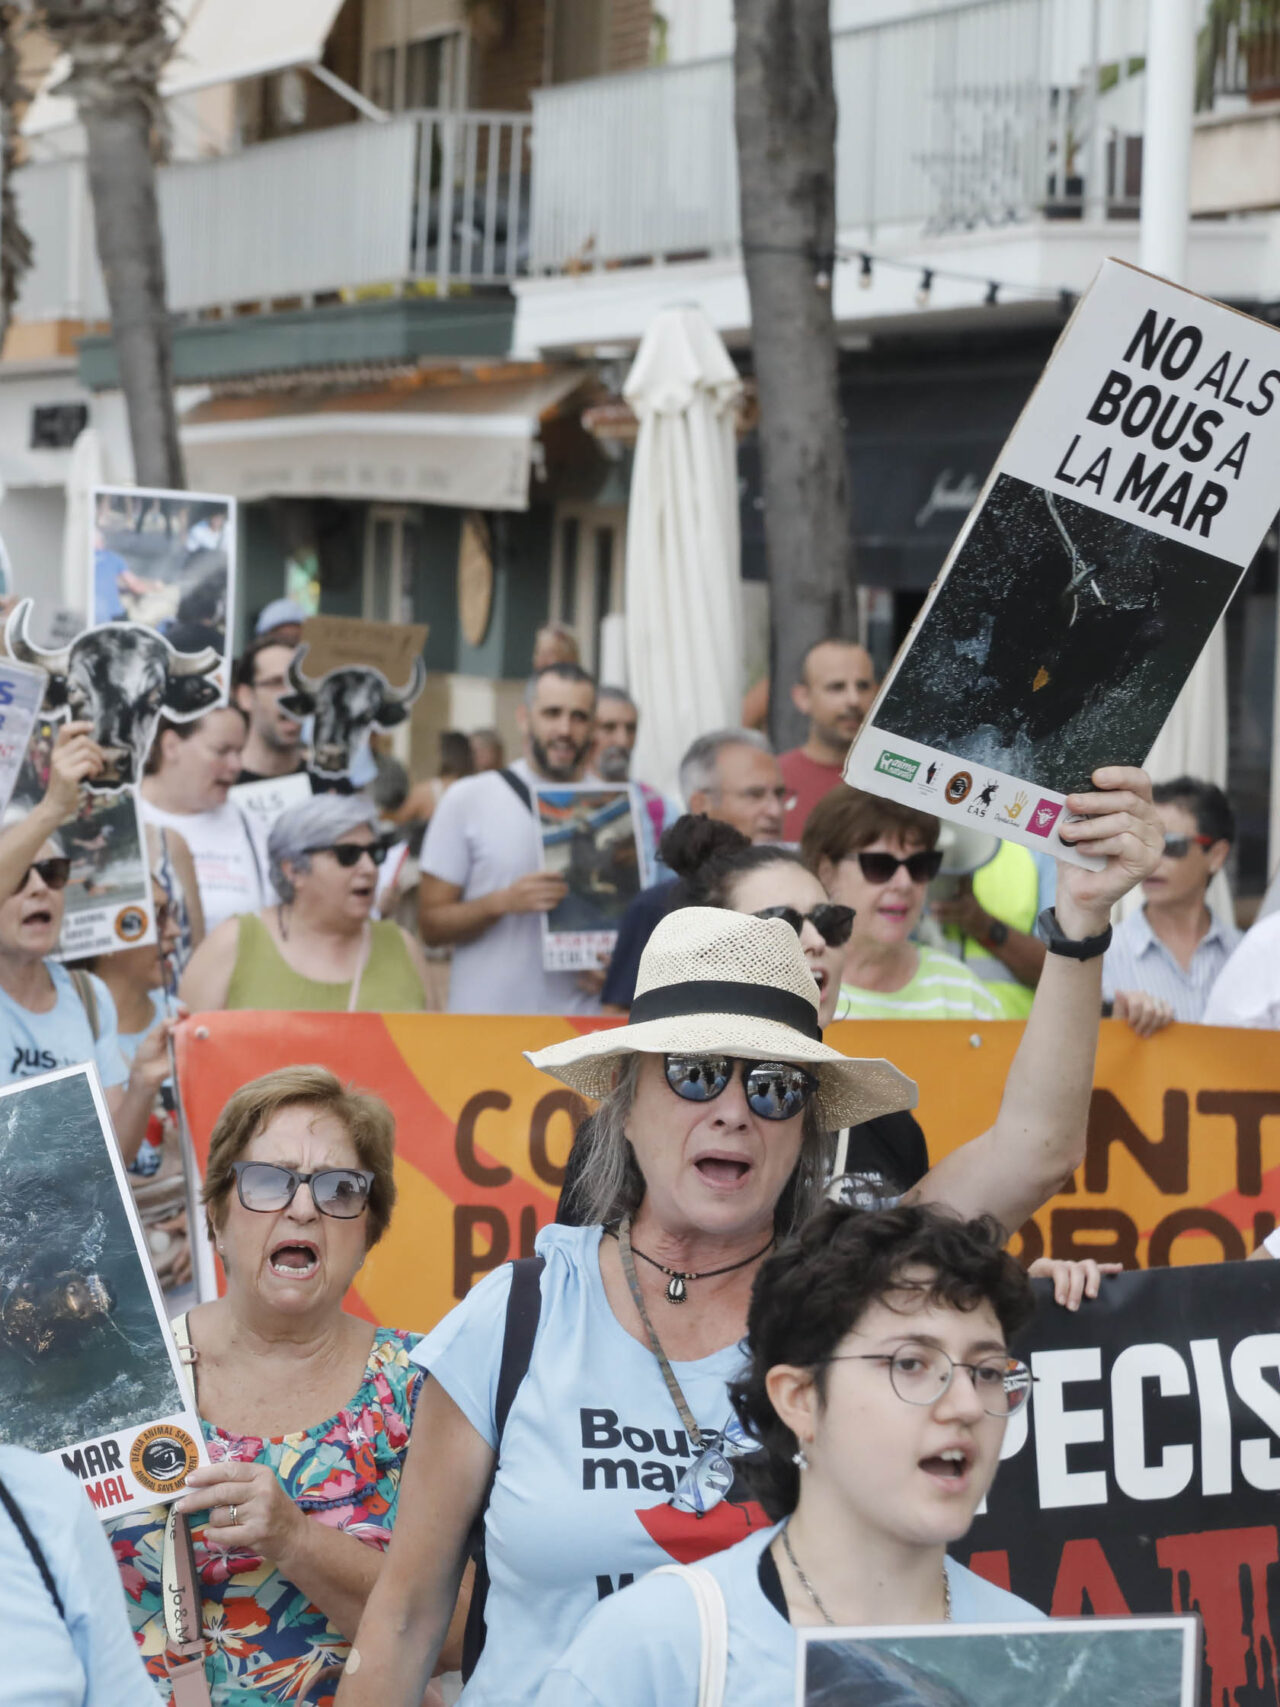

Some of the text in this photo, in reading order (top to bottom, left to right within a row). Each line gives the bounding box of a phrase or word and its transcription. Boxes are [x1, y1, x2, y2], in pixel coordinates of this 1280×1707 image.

[1122, 308, 1280, 417] NO ALS
[1086, 369, 1252, 480] BOUS A
[1054, 434, 1229, 539] LA MAR
[967, 805, 987, 818] CAS
[454, 1088, 592, 1188] CO
[1058, 1086, 1280, 1198] NT
[61, 1439, 125, 1481] MAR
[143, 1426, 174, 1441] ANIMAL
[175, 1430, 193, 1447] SAVE
[579, 1407, 725, 1459] Bous
[135, 1470, 156, 1491] ANIMAL
[157, 1482, 175, 1493] SAVE
